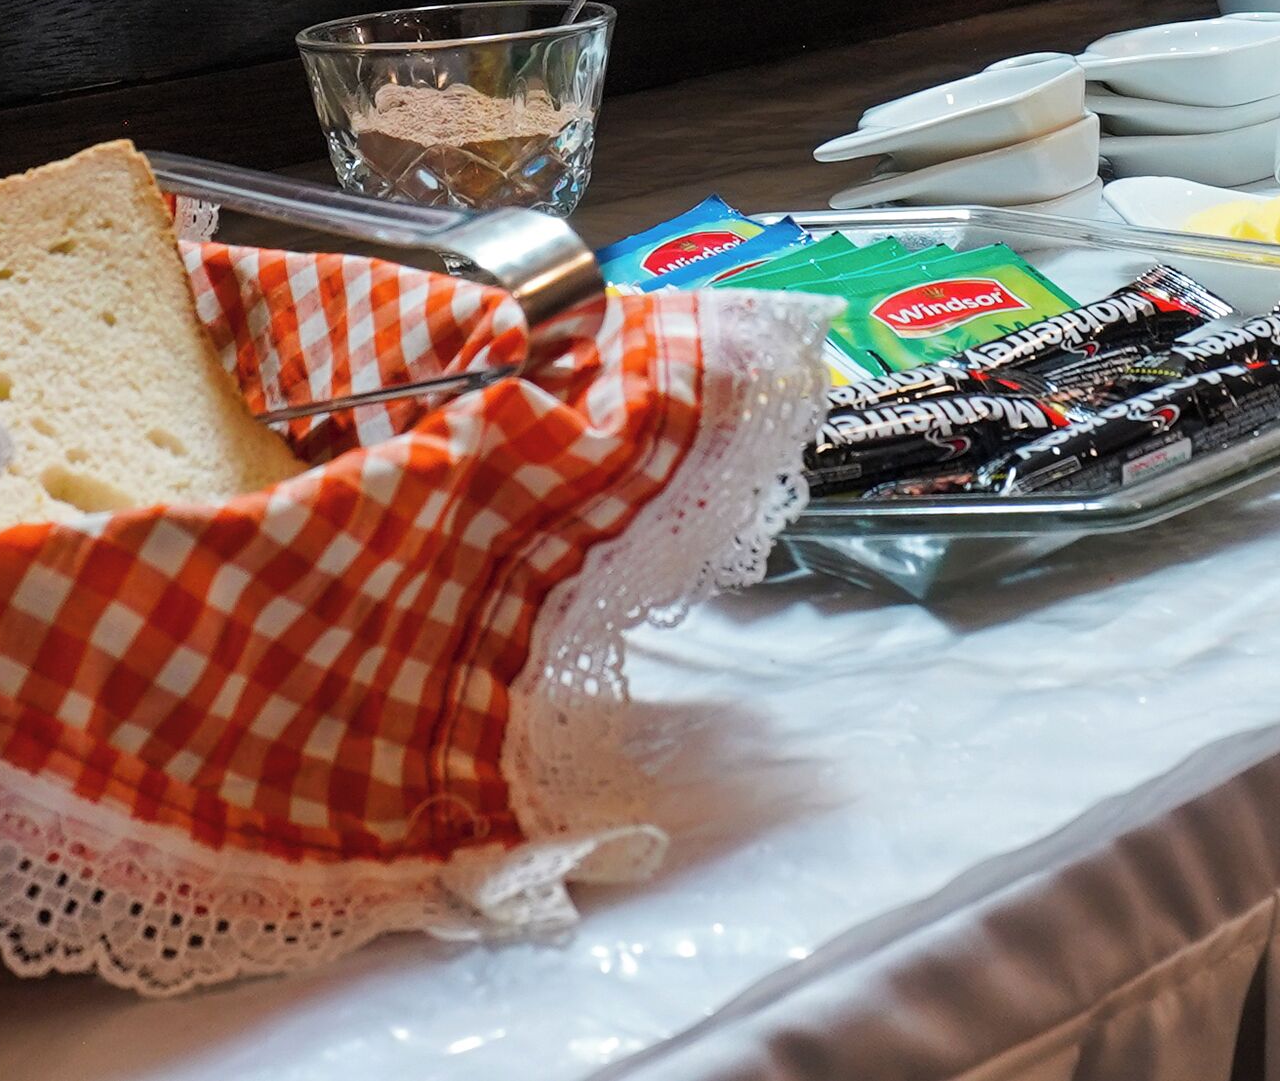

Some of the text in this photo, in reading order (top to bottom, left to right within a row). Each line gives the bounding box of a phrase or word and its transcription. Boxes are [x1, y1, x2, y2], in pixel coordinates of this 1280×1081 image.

[887, 291, 1004, 325] Windsor
[967, 291, 1157, 370] Monterrey
[827, 365, 969, 410] Monte
